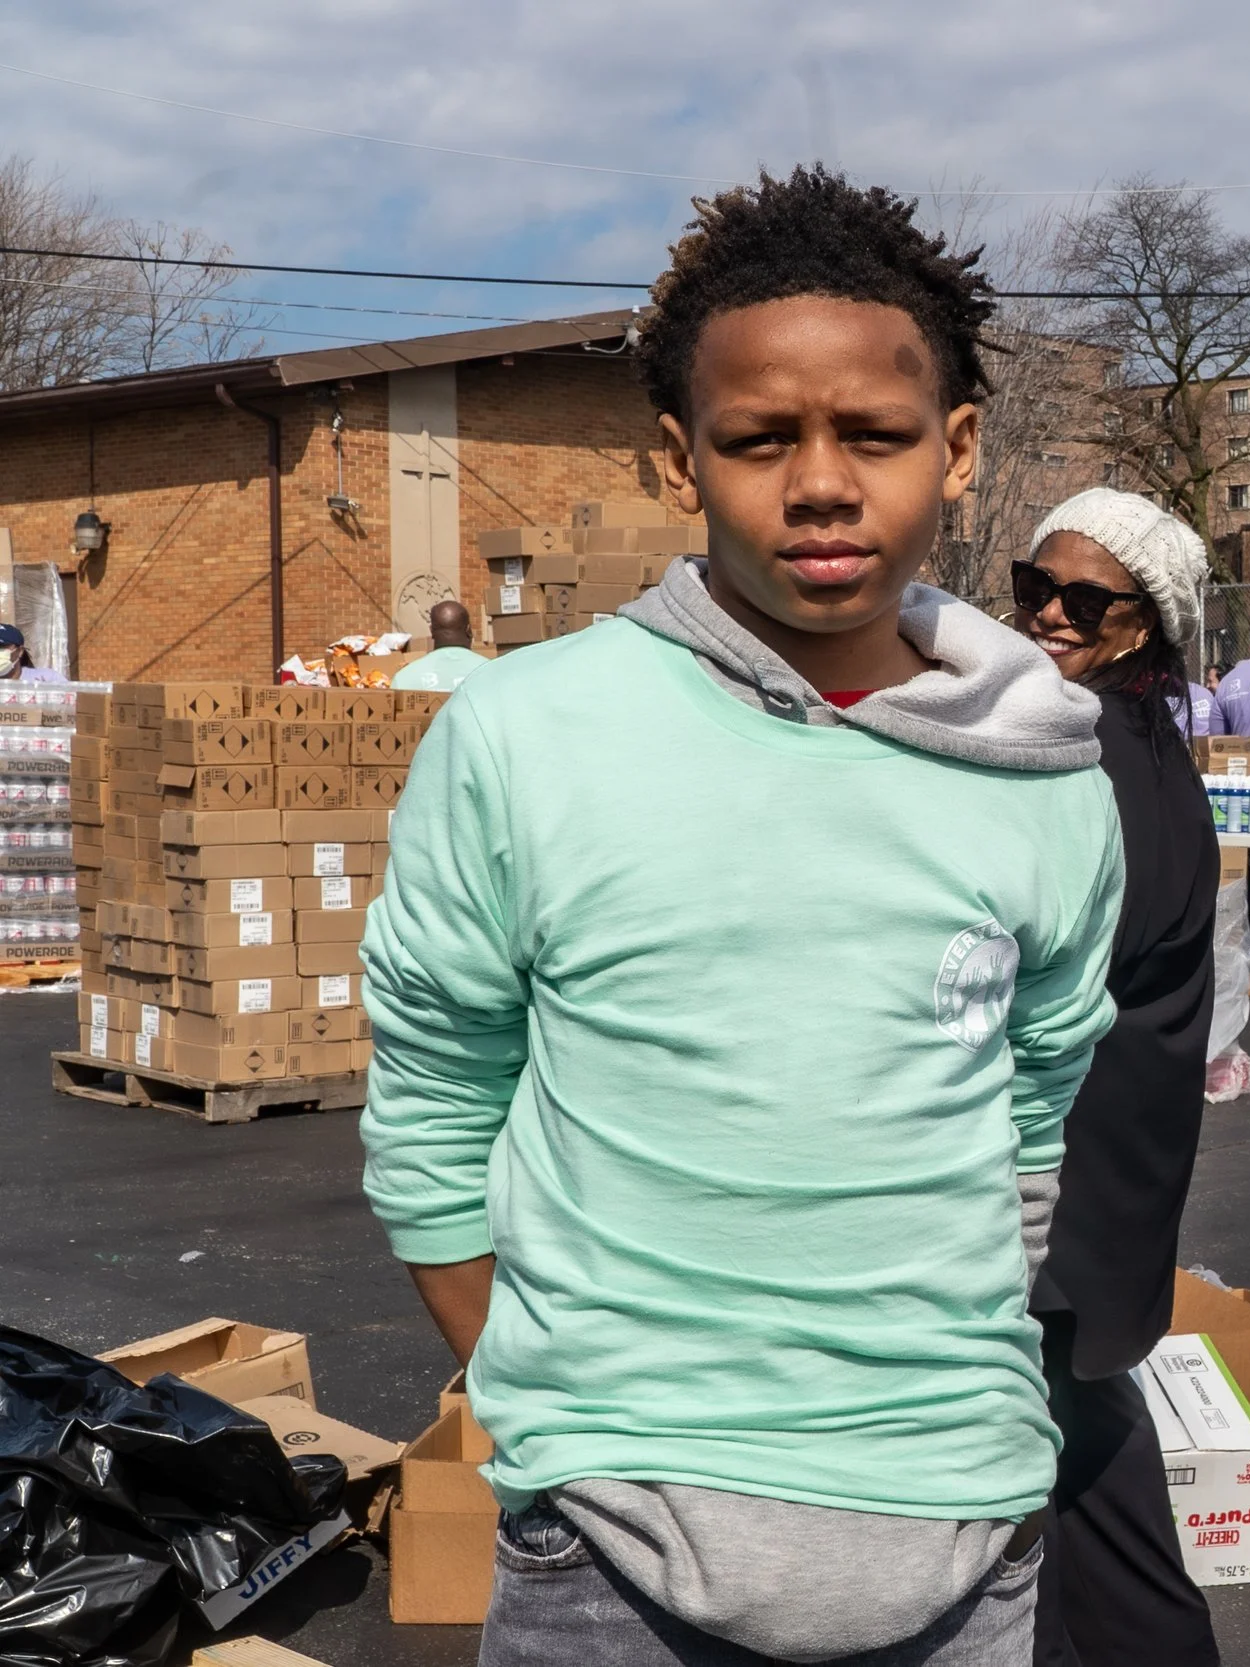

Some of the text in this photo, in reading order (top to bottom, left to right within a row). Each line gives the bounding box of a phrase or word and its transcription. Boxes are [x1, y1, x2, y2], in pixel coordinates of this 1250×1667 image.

[6, 947, 74, 957] POWERADE
[1195, 1529, 1240, 1546] CHEEZ-IT
[238, 1533, 313, 1599] JIFFY
